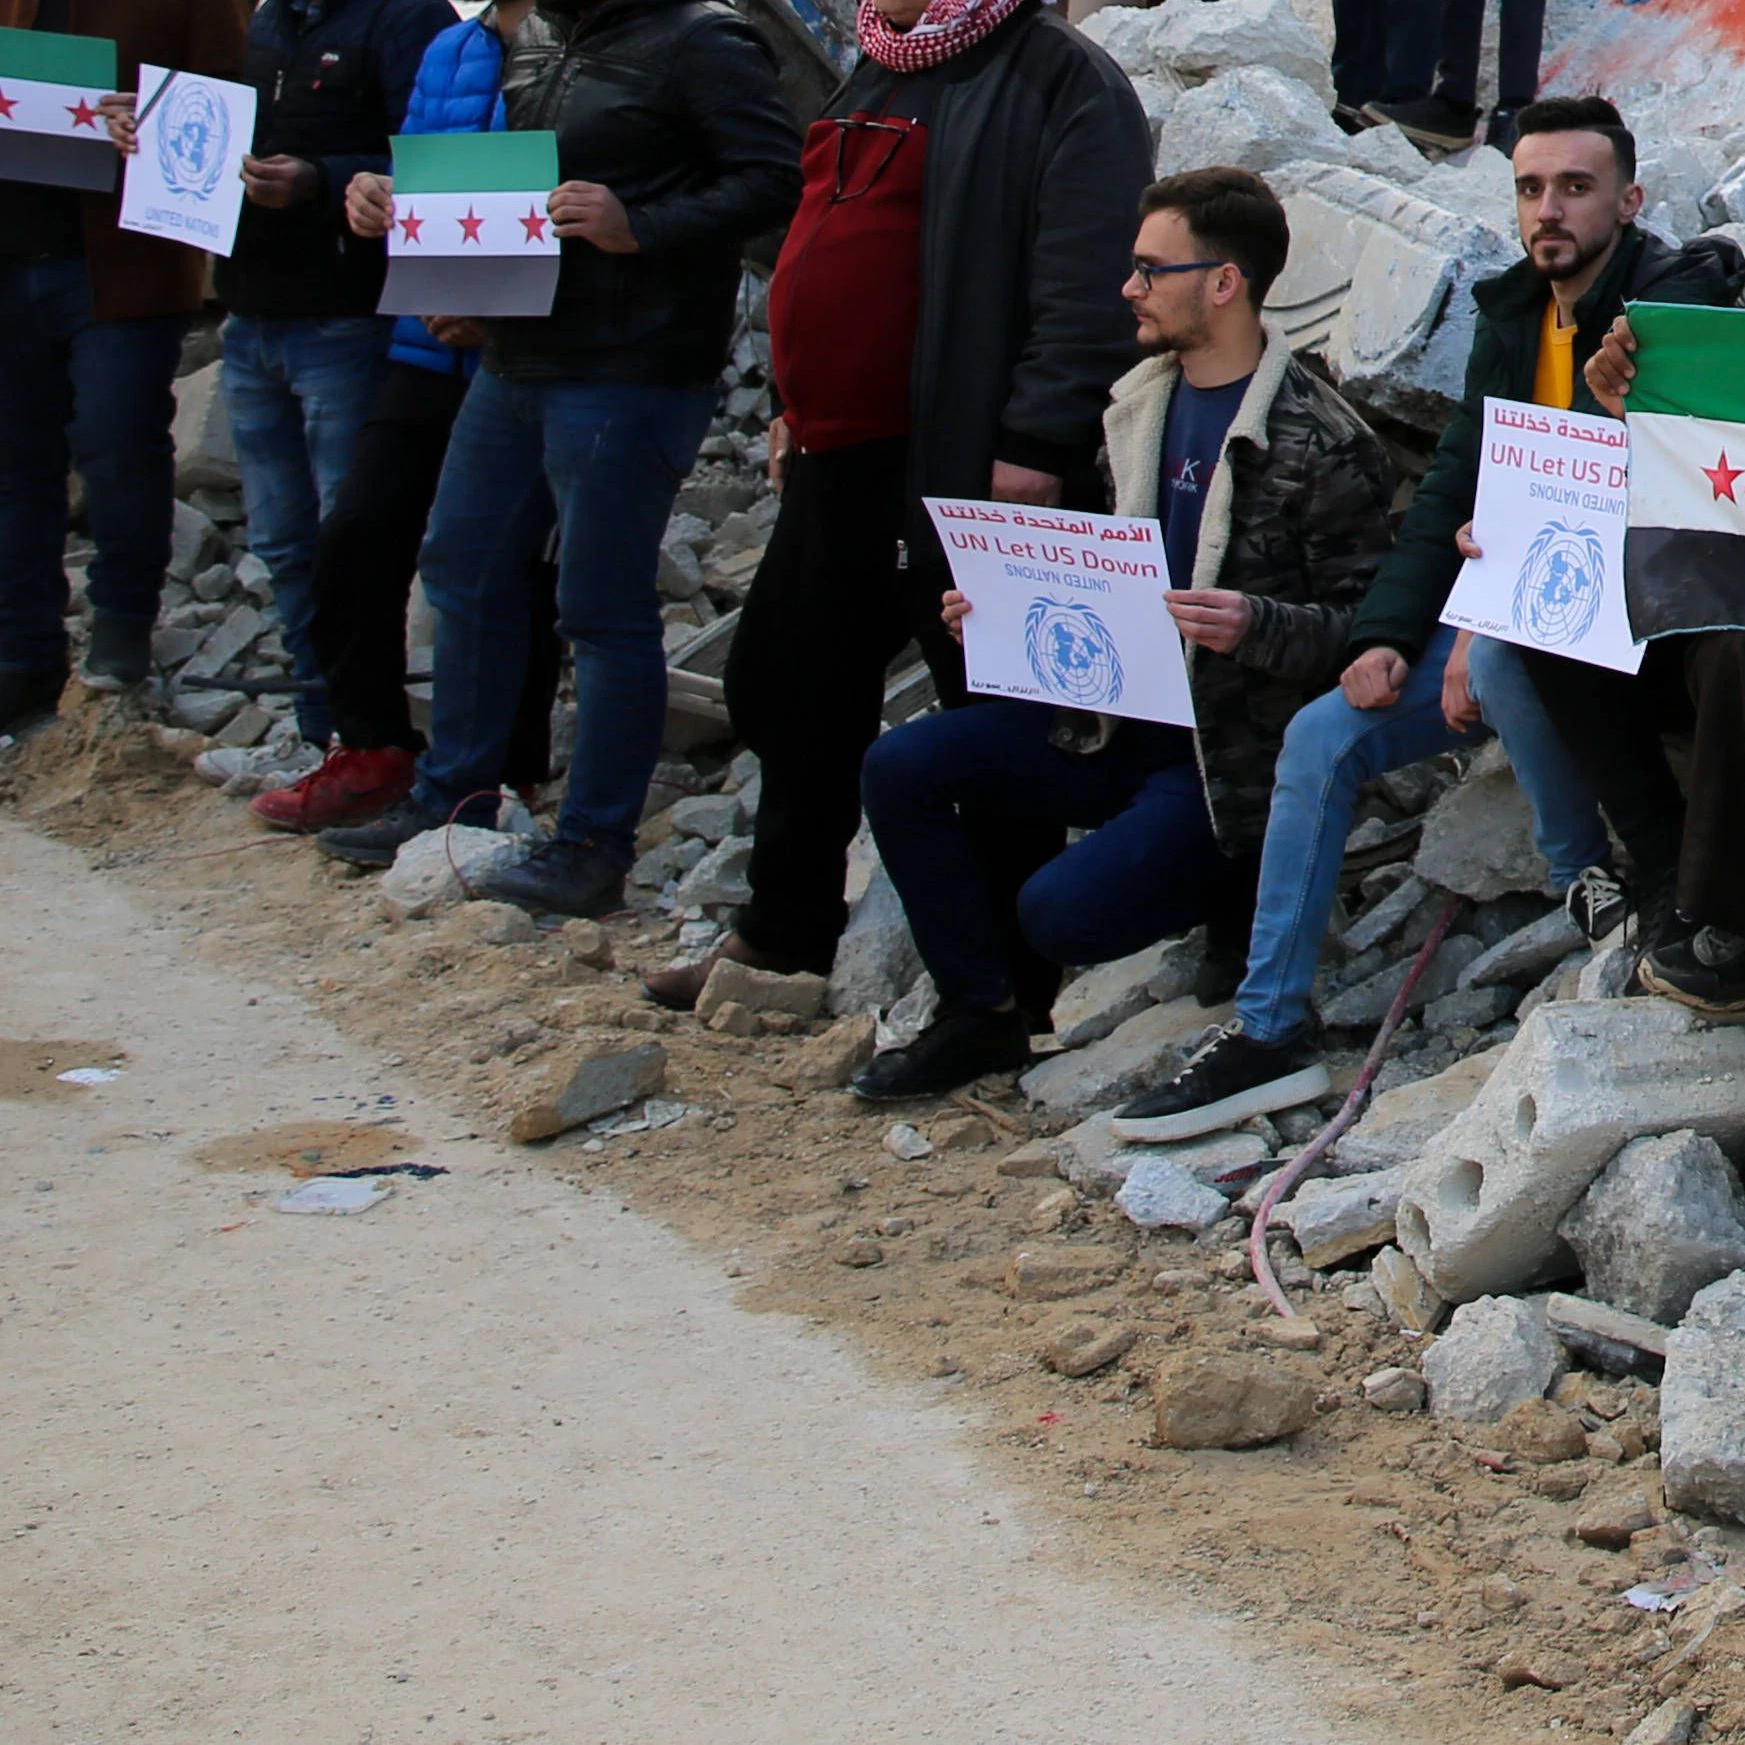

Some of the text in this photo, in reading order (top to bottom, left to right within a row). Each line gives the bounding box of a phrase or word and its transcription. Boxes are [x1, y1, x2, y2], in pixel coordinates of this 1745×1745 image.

[1493, 407, 1552, 434] خذلتنا
[1490, 442, 1524, 469] UN
[1530, 450, 1565, 478] Let
[1572, 459, 1602, 484] US
[1529, 482, 1626, 516] UNITED NATIONS
[938, 505, 1152, 543] الأمم المتحدة خذلتنا
[949, 530, 1159, 578] UN Let US Down
[1004, 563, 1112, 594] UNITED NATIONS
